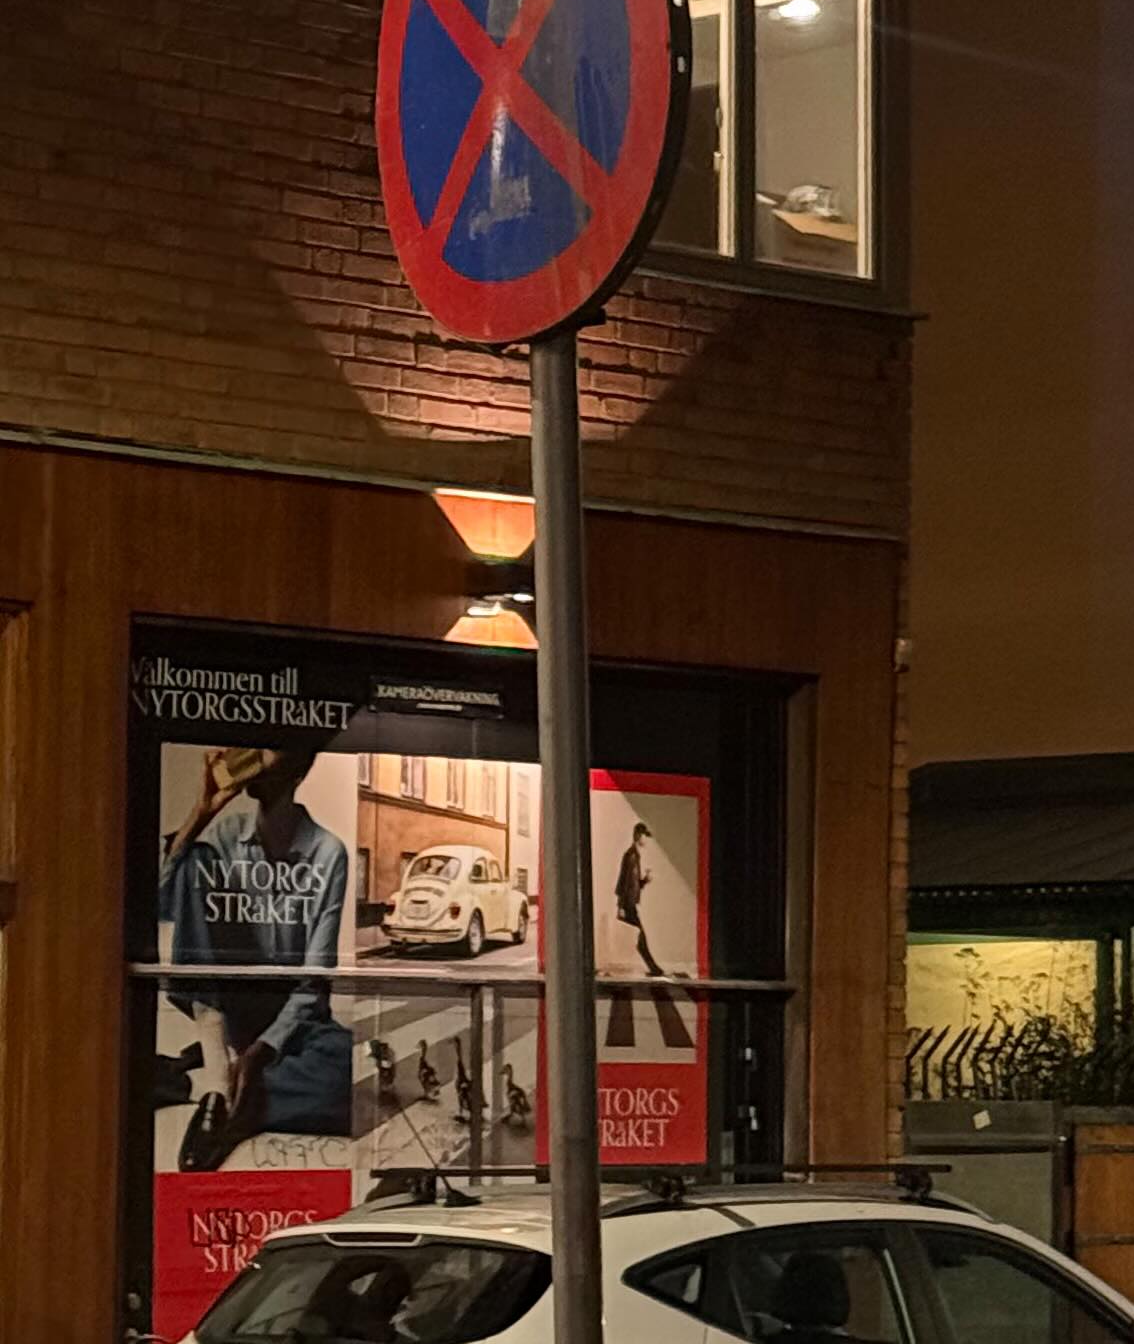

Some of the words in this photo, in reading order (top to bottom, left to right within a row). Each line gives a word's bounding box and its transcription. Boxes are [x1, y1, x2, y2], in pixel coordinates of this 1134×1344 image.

[271, 666, 299, 696] till
[194, 859, 327, 893] NYTORGS
[597, 1087, 681, 1116] TORGS
